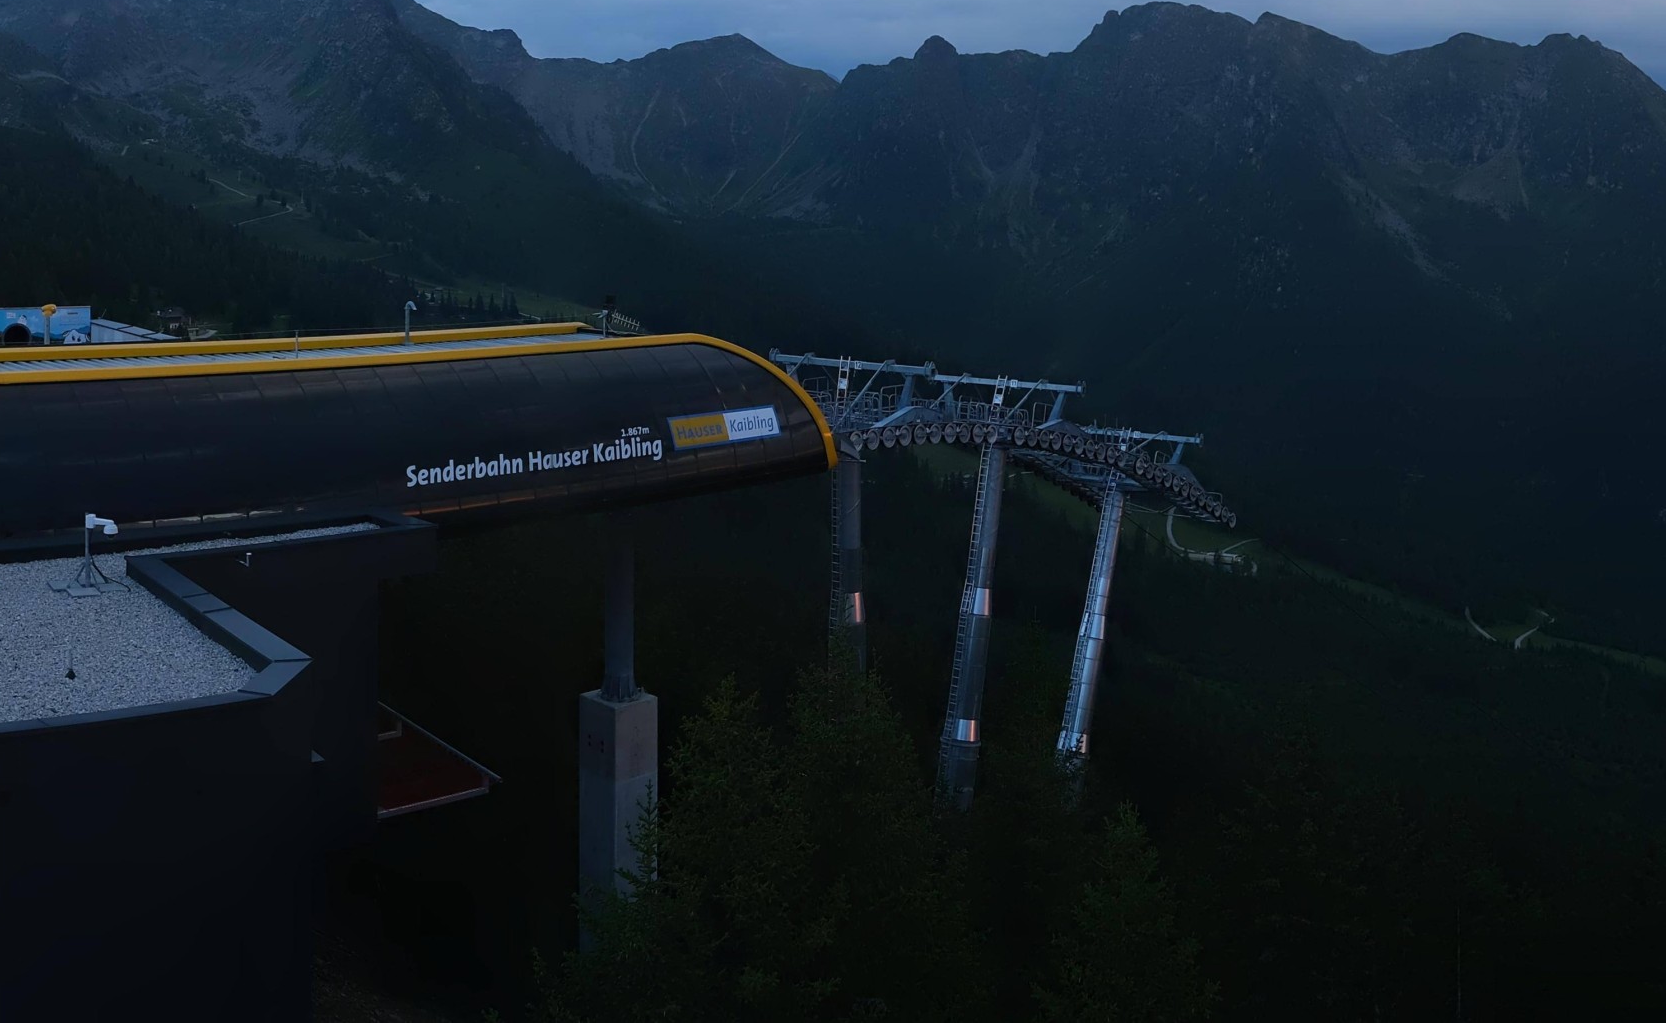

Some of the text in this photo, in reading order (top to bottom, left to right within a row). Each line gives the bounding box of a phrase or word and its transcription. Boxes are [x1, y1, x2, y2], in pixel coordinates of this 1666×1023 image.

[621, 426, 650, 438] 1.867m
[676, 414, 775, 441] HAUSER Kaibling
[406, 436, 663, 488] Senderbahn Hauser Kaibling
